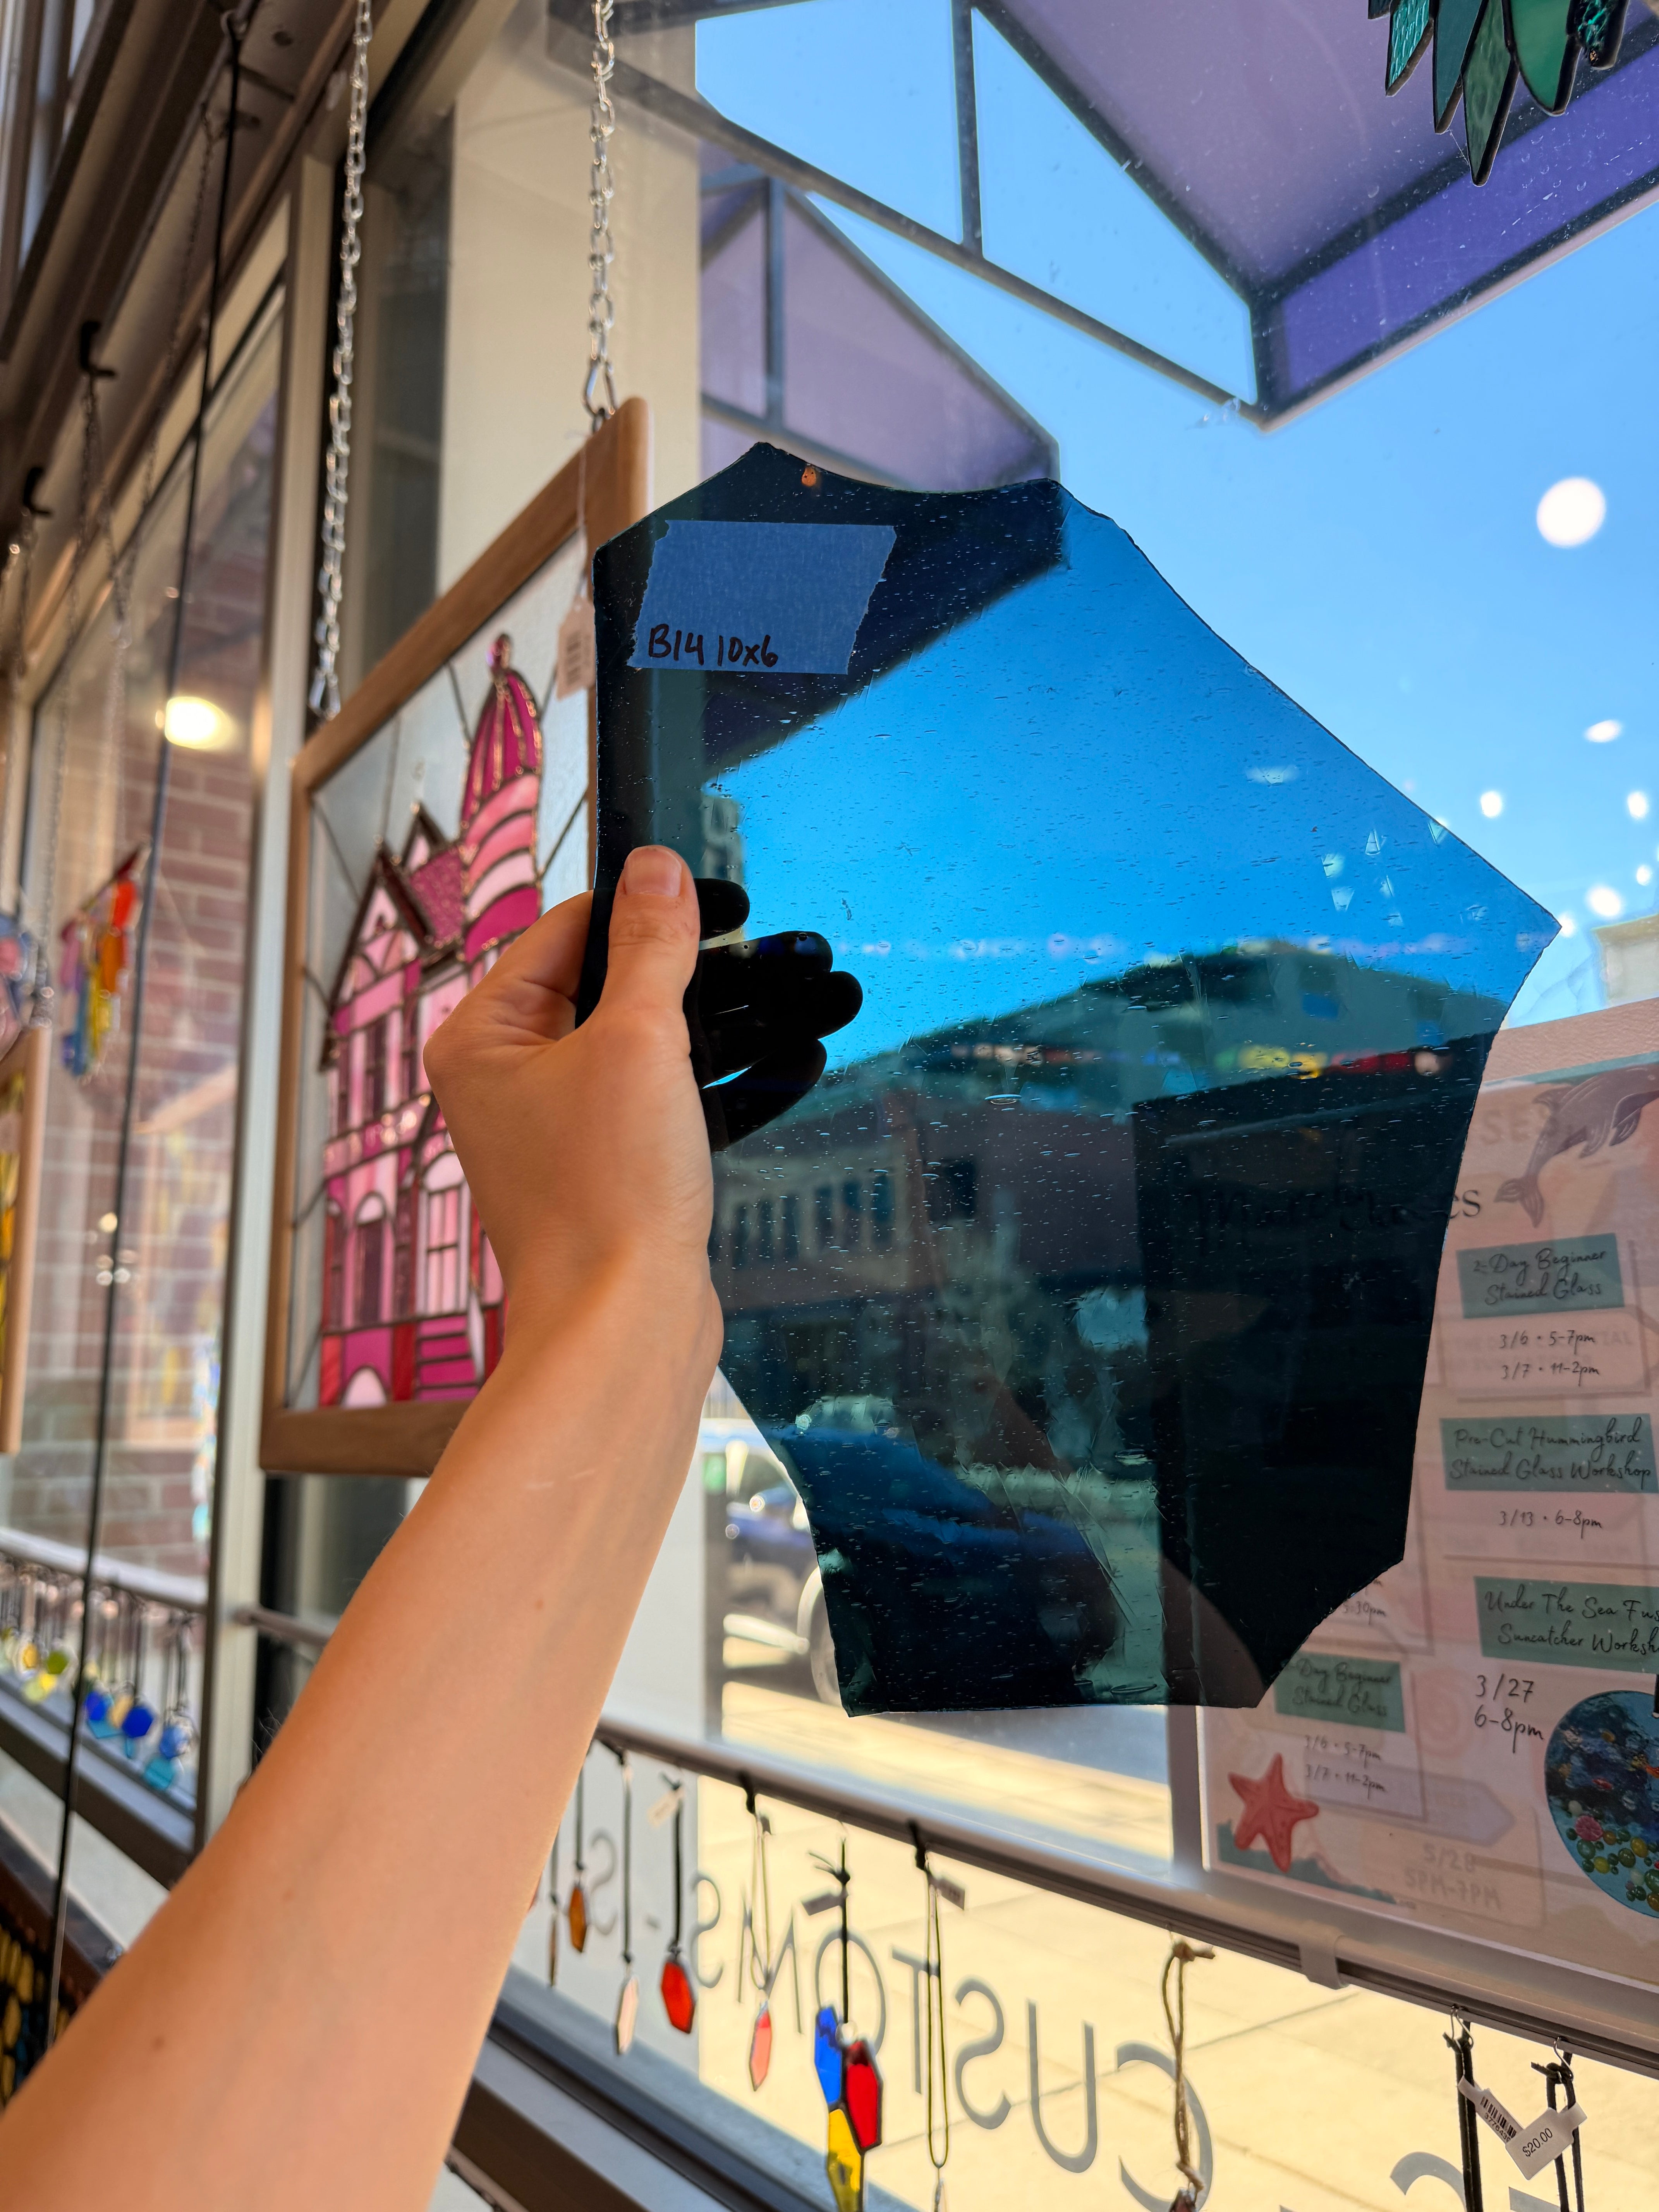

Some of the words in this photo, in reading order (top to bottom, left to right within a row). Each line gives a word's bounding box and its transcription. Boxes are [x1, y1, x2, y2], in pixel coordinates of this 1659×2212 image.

[648, 623, 704, 666] B14
[718, 634, 778, 667] 10x6
[1473, 1253, 1530, 1286] 2-Day
[1535, 1247, 1606, 1279] Beginner
[1485, 1272, 1549, 1305] Stained
[1553, 1273, 1601, 1299] Glass
[1499, 1330, 1528, 1349] 3/6
[1549, 1330, 1595, 1355] 5-7pm
[1501, 1362, 1530, 1380] 3/7
[1551, 1361, 1600, 1387] 11-2pm
[1454, 1425, 1523, 1448] Pre-Cut
[1530, 1417, 1642, 1462] Hummingbird
[1450, 1451, 1512, 1479] Stained
[1515, 1454, 1563, 1480] Glass
[1570, 1450, 1651, 1490] Workshop
[1499, 1509, 1534, 1527] 3/13
[1555, 1509, 1602, 1539] 6-8pm
[1484, 1583, 1535, 1612] Under
[1542, 1586, 1574, 1614] The
[1582, 1597, 1619, 1618] Sea
[1498, 1620, 1584, 1646] Suncatcher
[1335, 1662, 1392, 1693] Beginner
[1476, 1673, 1534, 1703] 3/27
[1292, 1684, 1343, 1707] Stained
[1348, 1691, 1387, 1716] Glass
[1474, 1704, 1544, 1753] 6-8pm
[1522, 2128, 1553, 2157] $20.00
